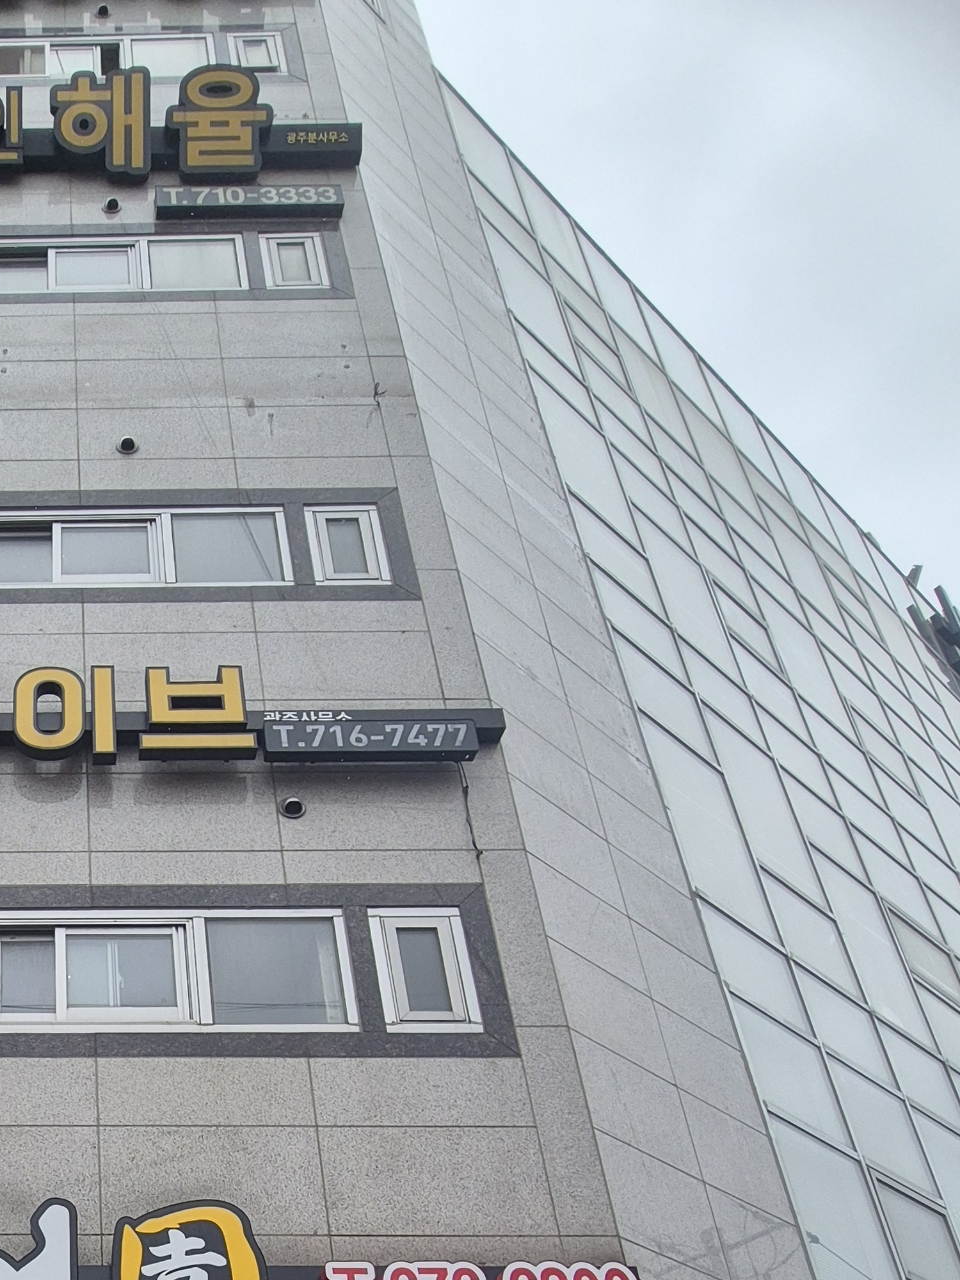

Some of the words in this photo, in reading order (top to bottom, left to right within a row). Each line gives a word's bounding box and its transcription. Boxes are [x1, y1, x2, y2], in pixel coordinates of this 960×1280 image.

[52, 66, 269, 173] 해율
[286, 131, 349, 144] 광주분사무소
[162, 186, 338, 205] T.710-3333
[272, 723, 468, 747] T.716-7477
